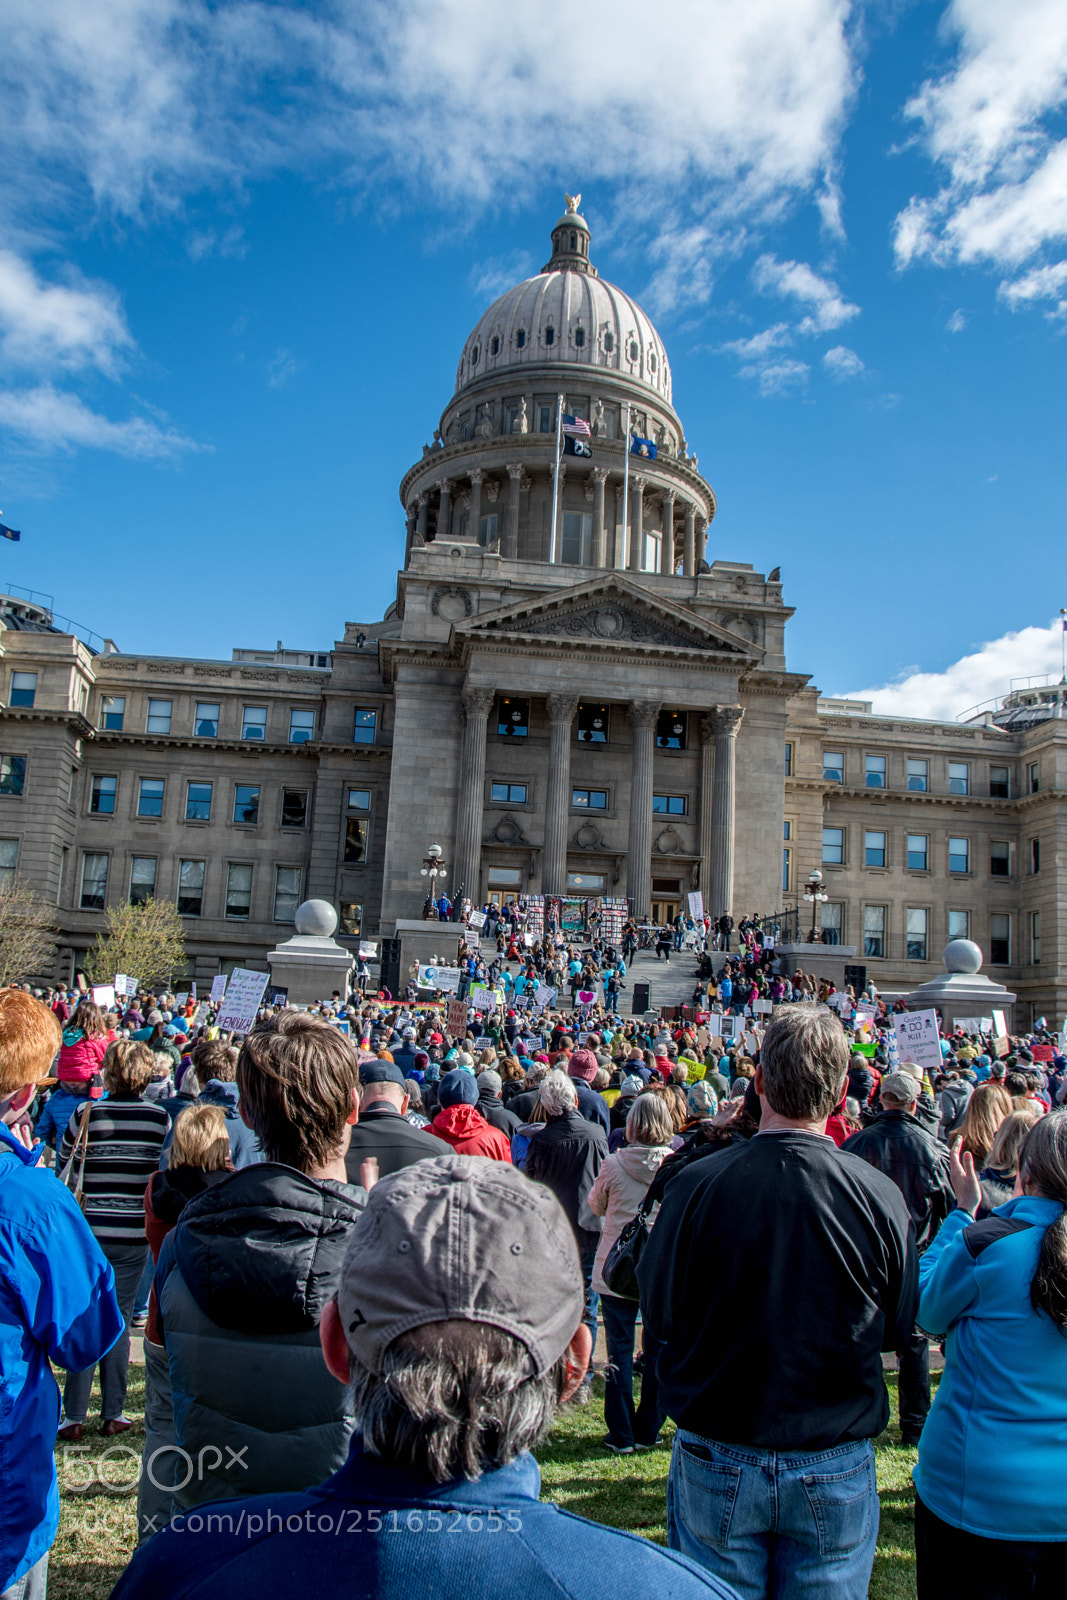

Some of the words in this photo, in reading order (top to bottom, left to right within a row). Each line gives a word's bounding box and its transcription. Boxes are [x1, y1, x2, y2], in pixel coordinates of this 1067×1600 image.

[452, 1003, 464, 1012] HOW
[450, 1014, 464, 1023] MANY
[910, 1022, 922, 1031] DO
